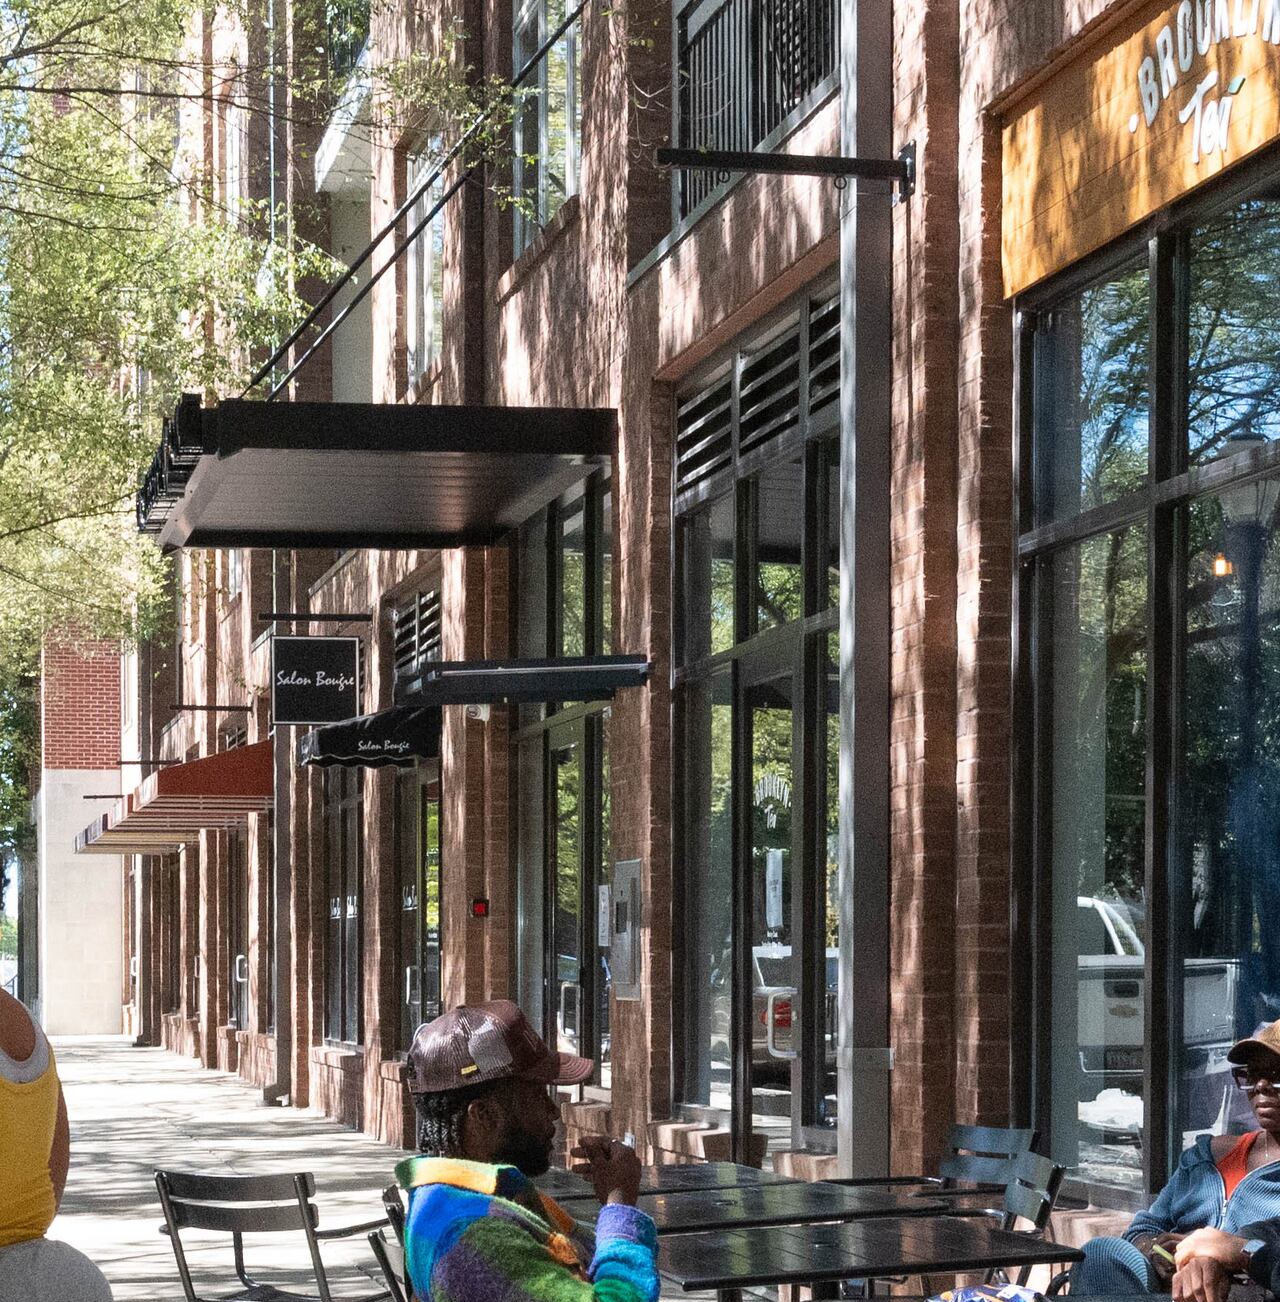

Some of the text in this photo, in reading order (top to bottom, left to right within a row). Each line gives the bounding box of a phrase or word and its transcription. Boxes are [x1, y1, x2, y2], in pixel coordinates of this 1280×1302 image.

[276, 670, 354, 691] Salon Bougie
[357, 739, 409, 753] Salon Bougie
